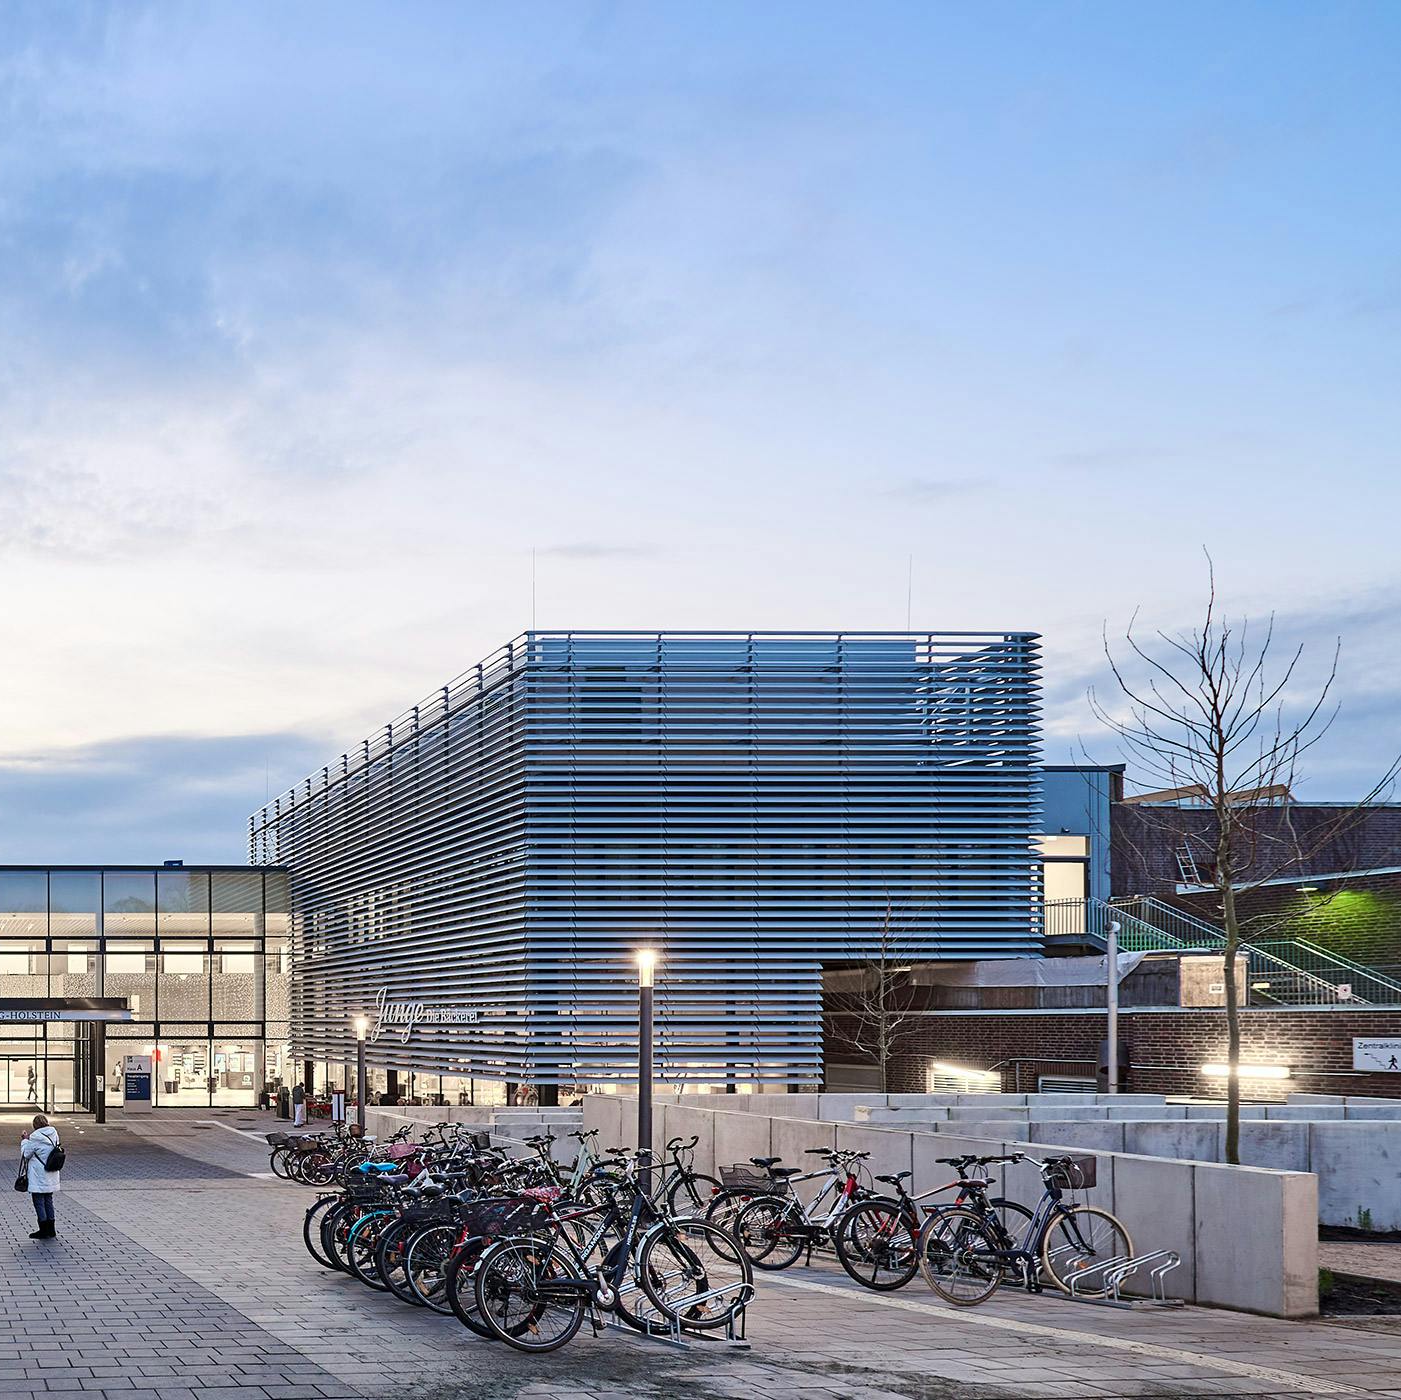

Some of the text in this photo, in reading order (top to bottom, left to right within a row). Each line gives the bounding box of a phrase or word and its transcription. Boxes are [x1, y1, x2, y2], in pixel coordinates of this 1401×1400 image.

[369, 985, 424, 1043] Junge
[425, 1009, 440, 1022] Die
[136, 1063, 143, 1071] A
[580, 1223, 606, 1261] RGAMONT
